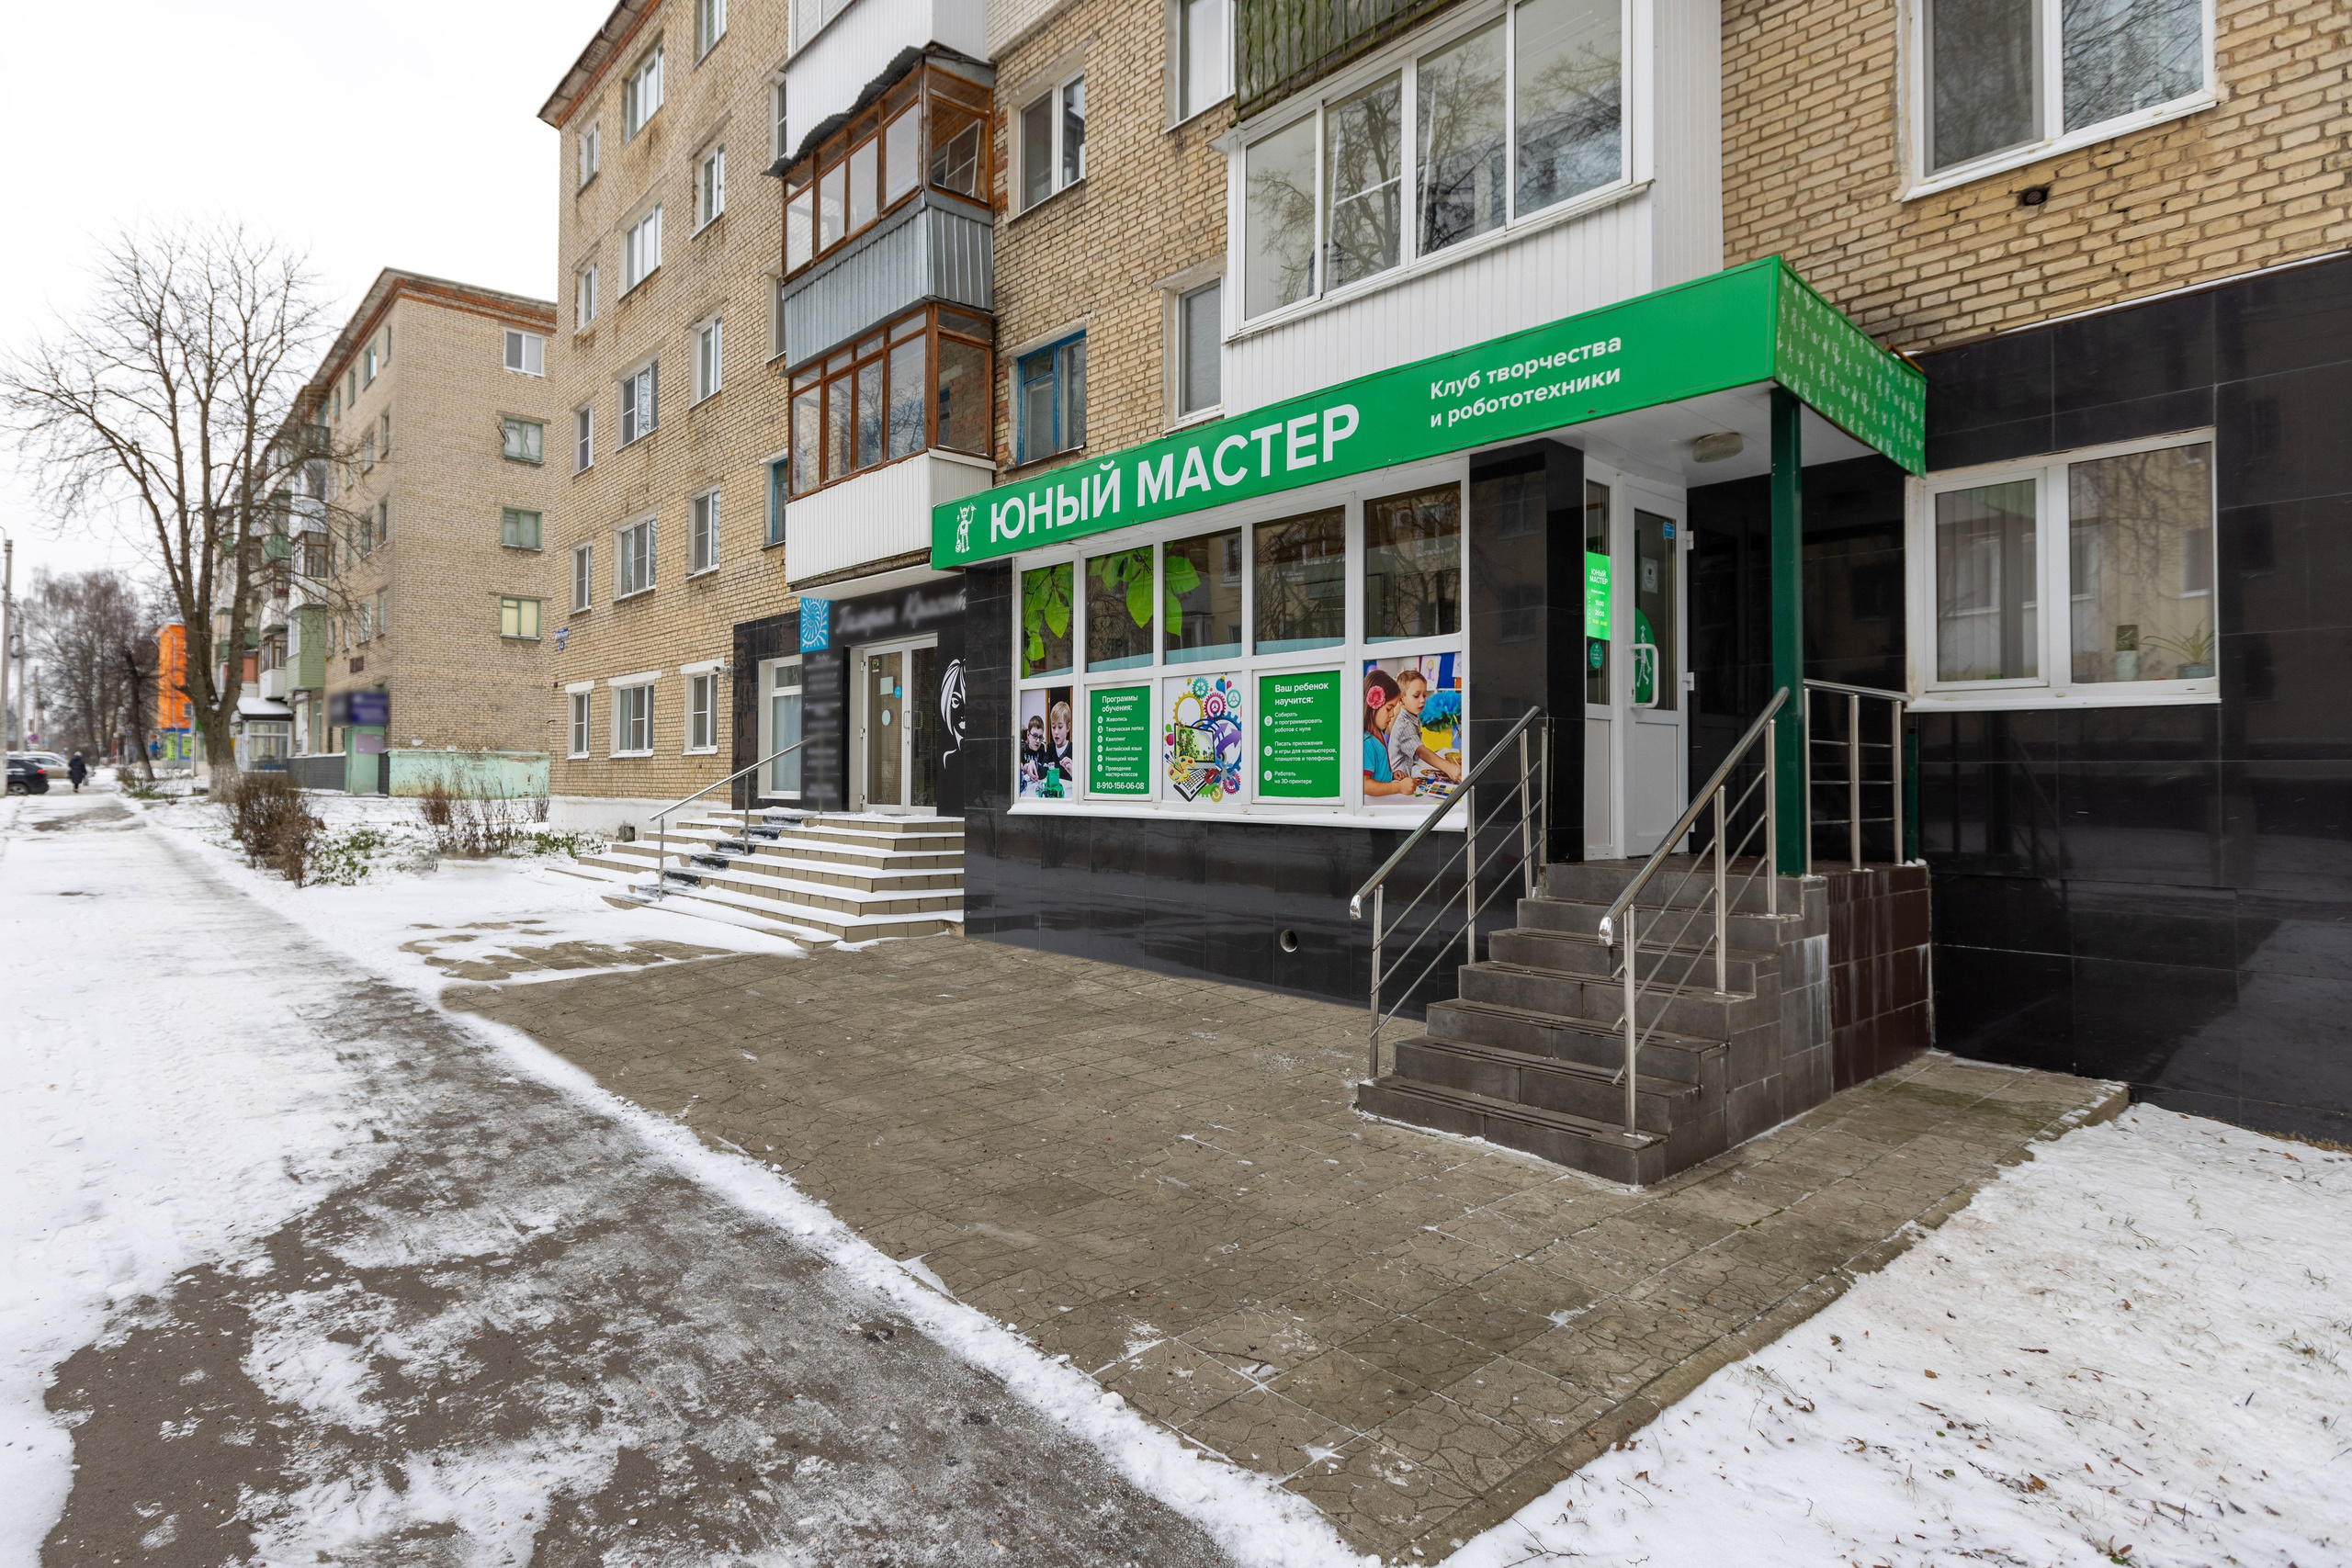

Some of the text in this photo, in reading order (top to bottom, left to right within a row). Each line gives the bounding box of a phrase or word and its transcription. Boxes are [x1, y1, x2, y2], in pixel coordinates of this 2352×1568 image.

[1430, 334, 1623, 400] Клуб творчества
[1430, 366, 1621, 428] и робототехники
[990, 403, 1361, 543] ЮНЫЙ МАСТЕР
[1591, 569, 1606, 577] ЮНЫЙ
[1589, 575, 1608, 585] МАСТЕР
[1275, 682, 1329, 693] Ваш ребенок
[1275, 697, 1313, 706] научится:
[1102, 705, 1132, 713] обучения:
